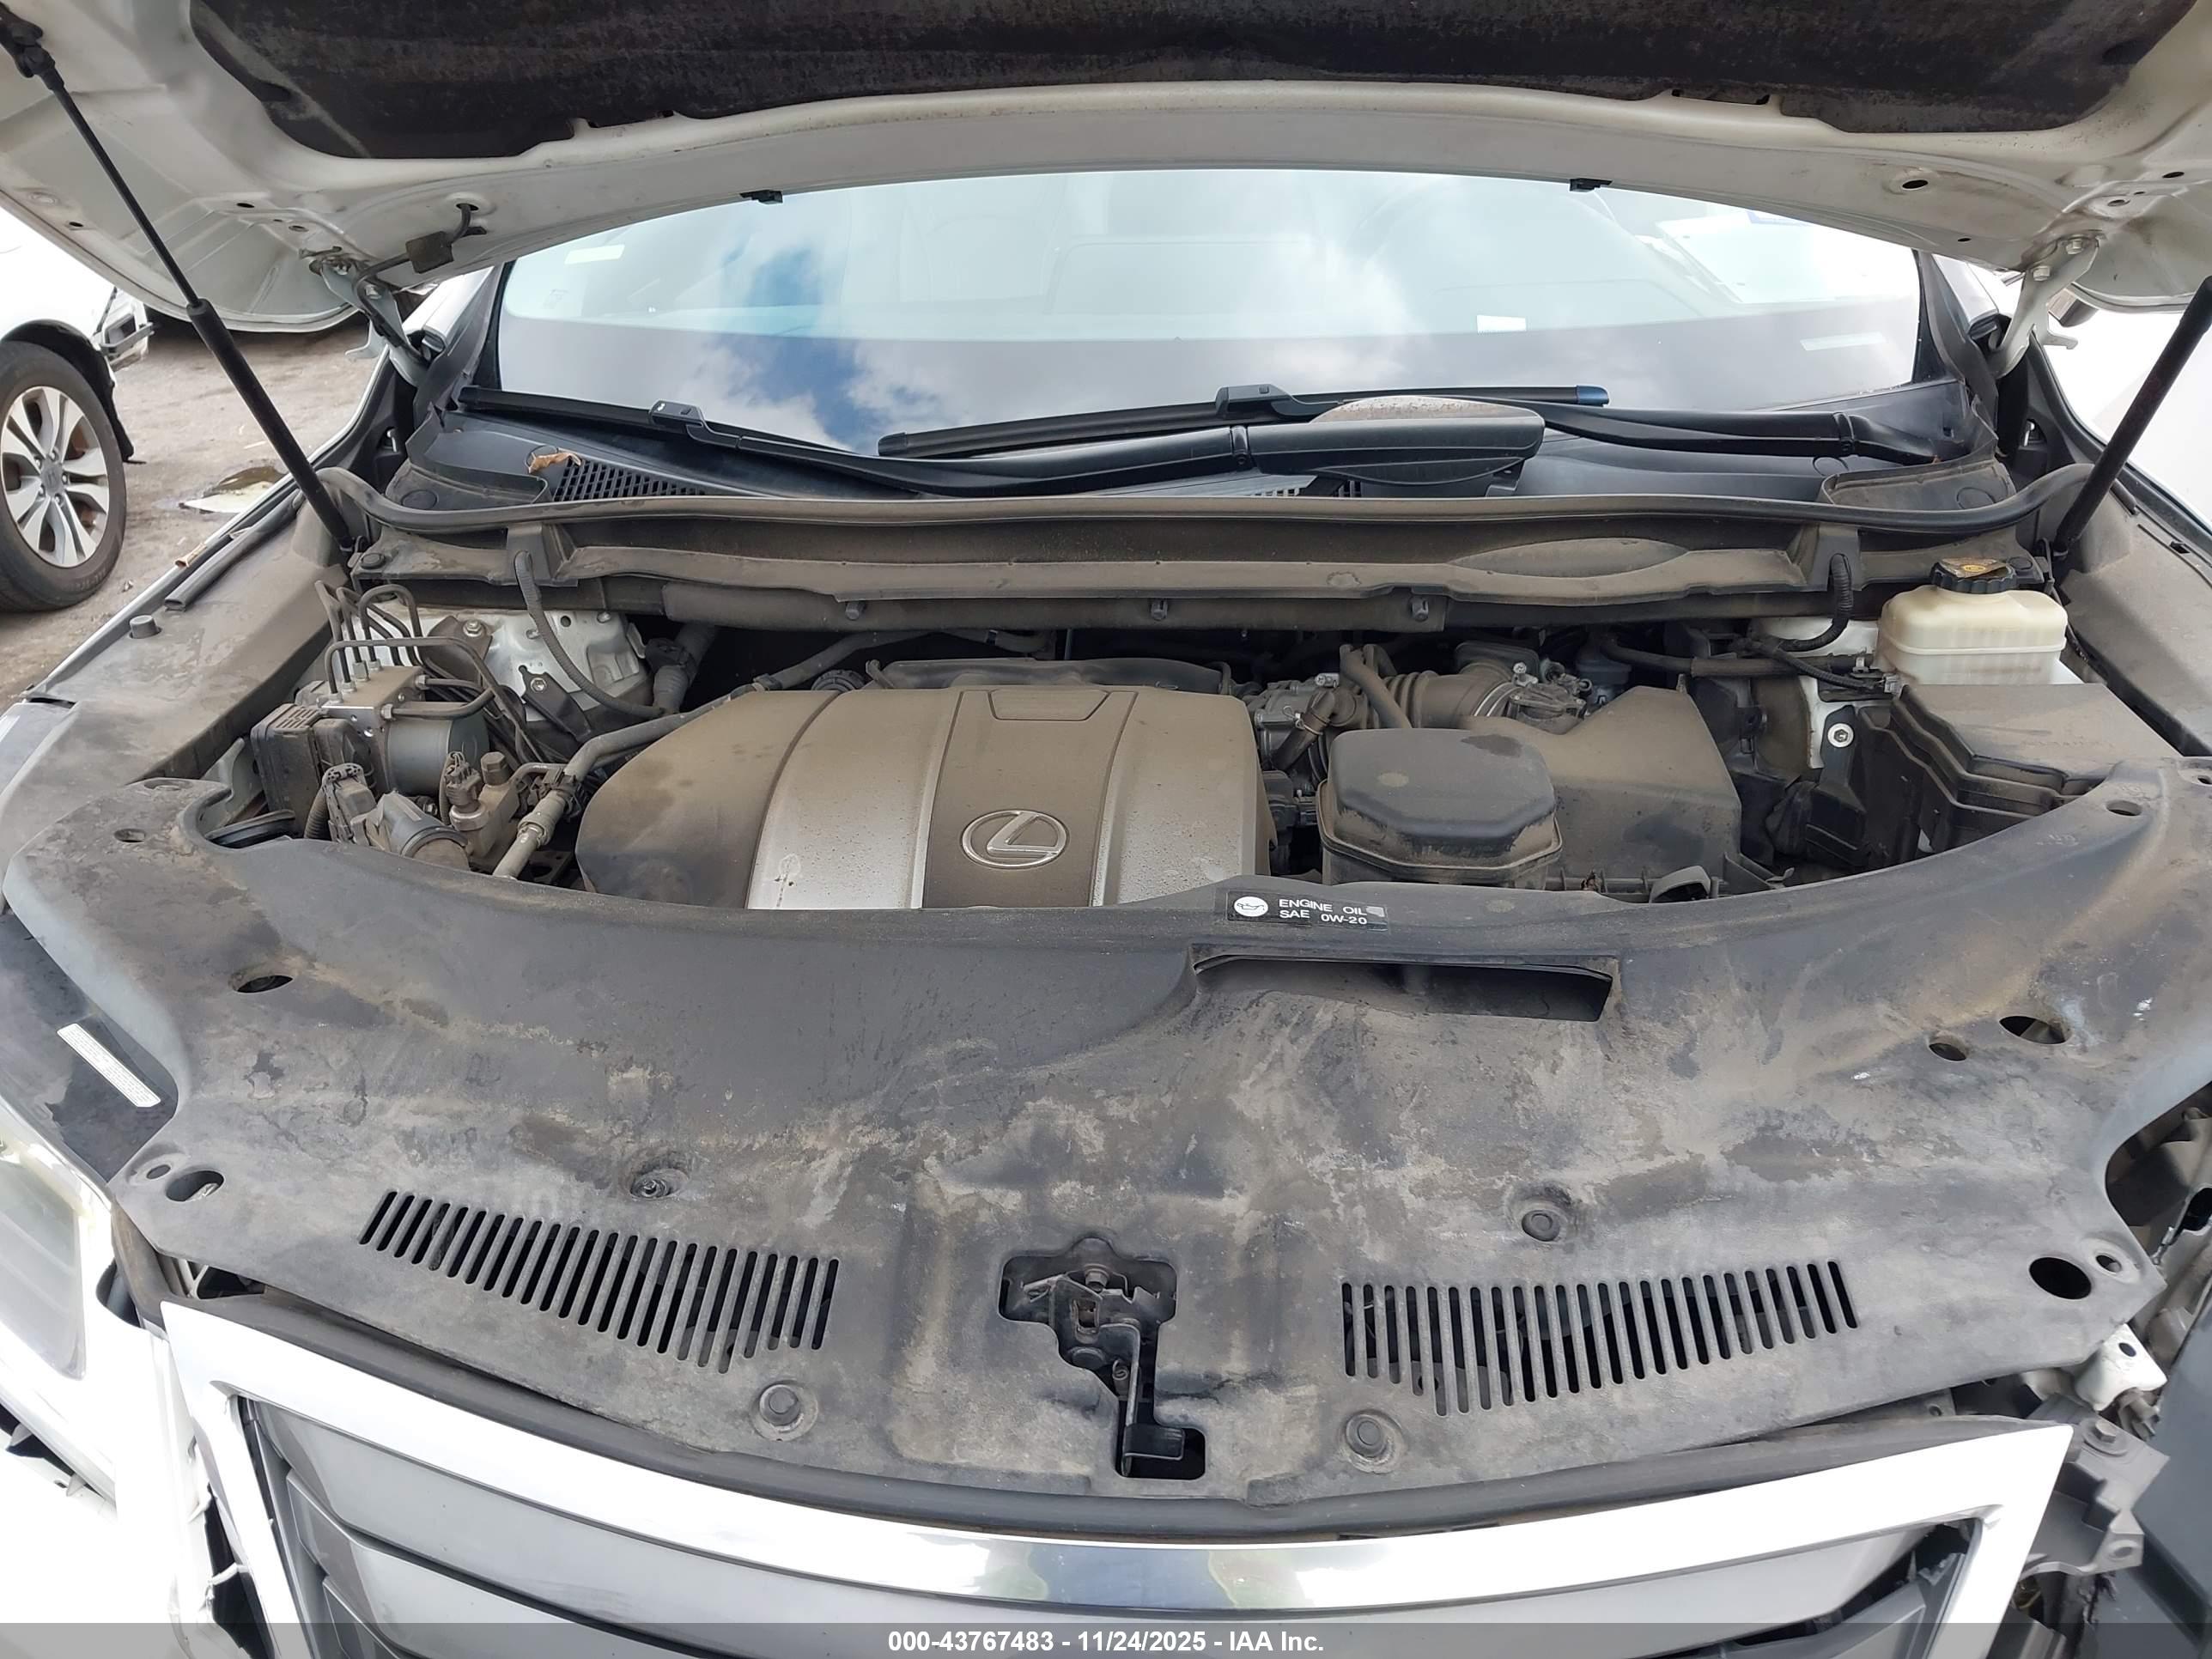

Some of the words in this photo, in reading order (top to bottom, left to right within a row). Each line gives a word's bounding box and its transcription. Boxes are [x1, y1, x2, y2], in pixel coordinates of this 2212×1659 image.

[1279, 898, 1334, 913] ENGINE
[1342, 906, 1368, 916] OIL
[1279, 909, 1310, 919] SAE
[1321, 913, 1368, 925] 0W-20
